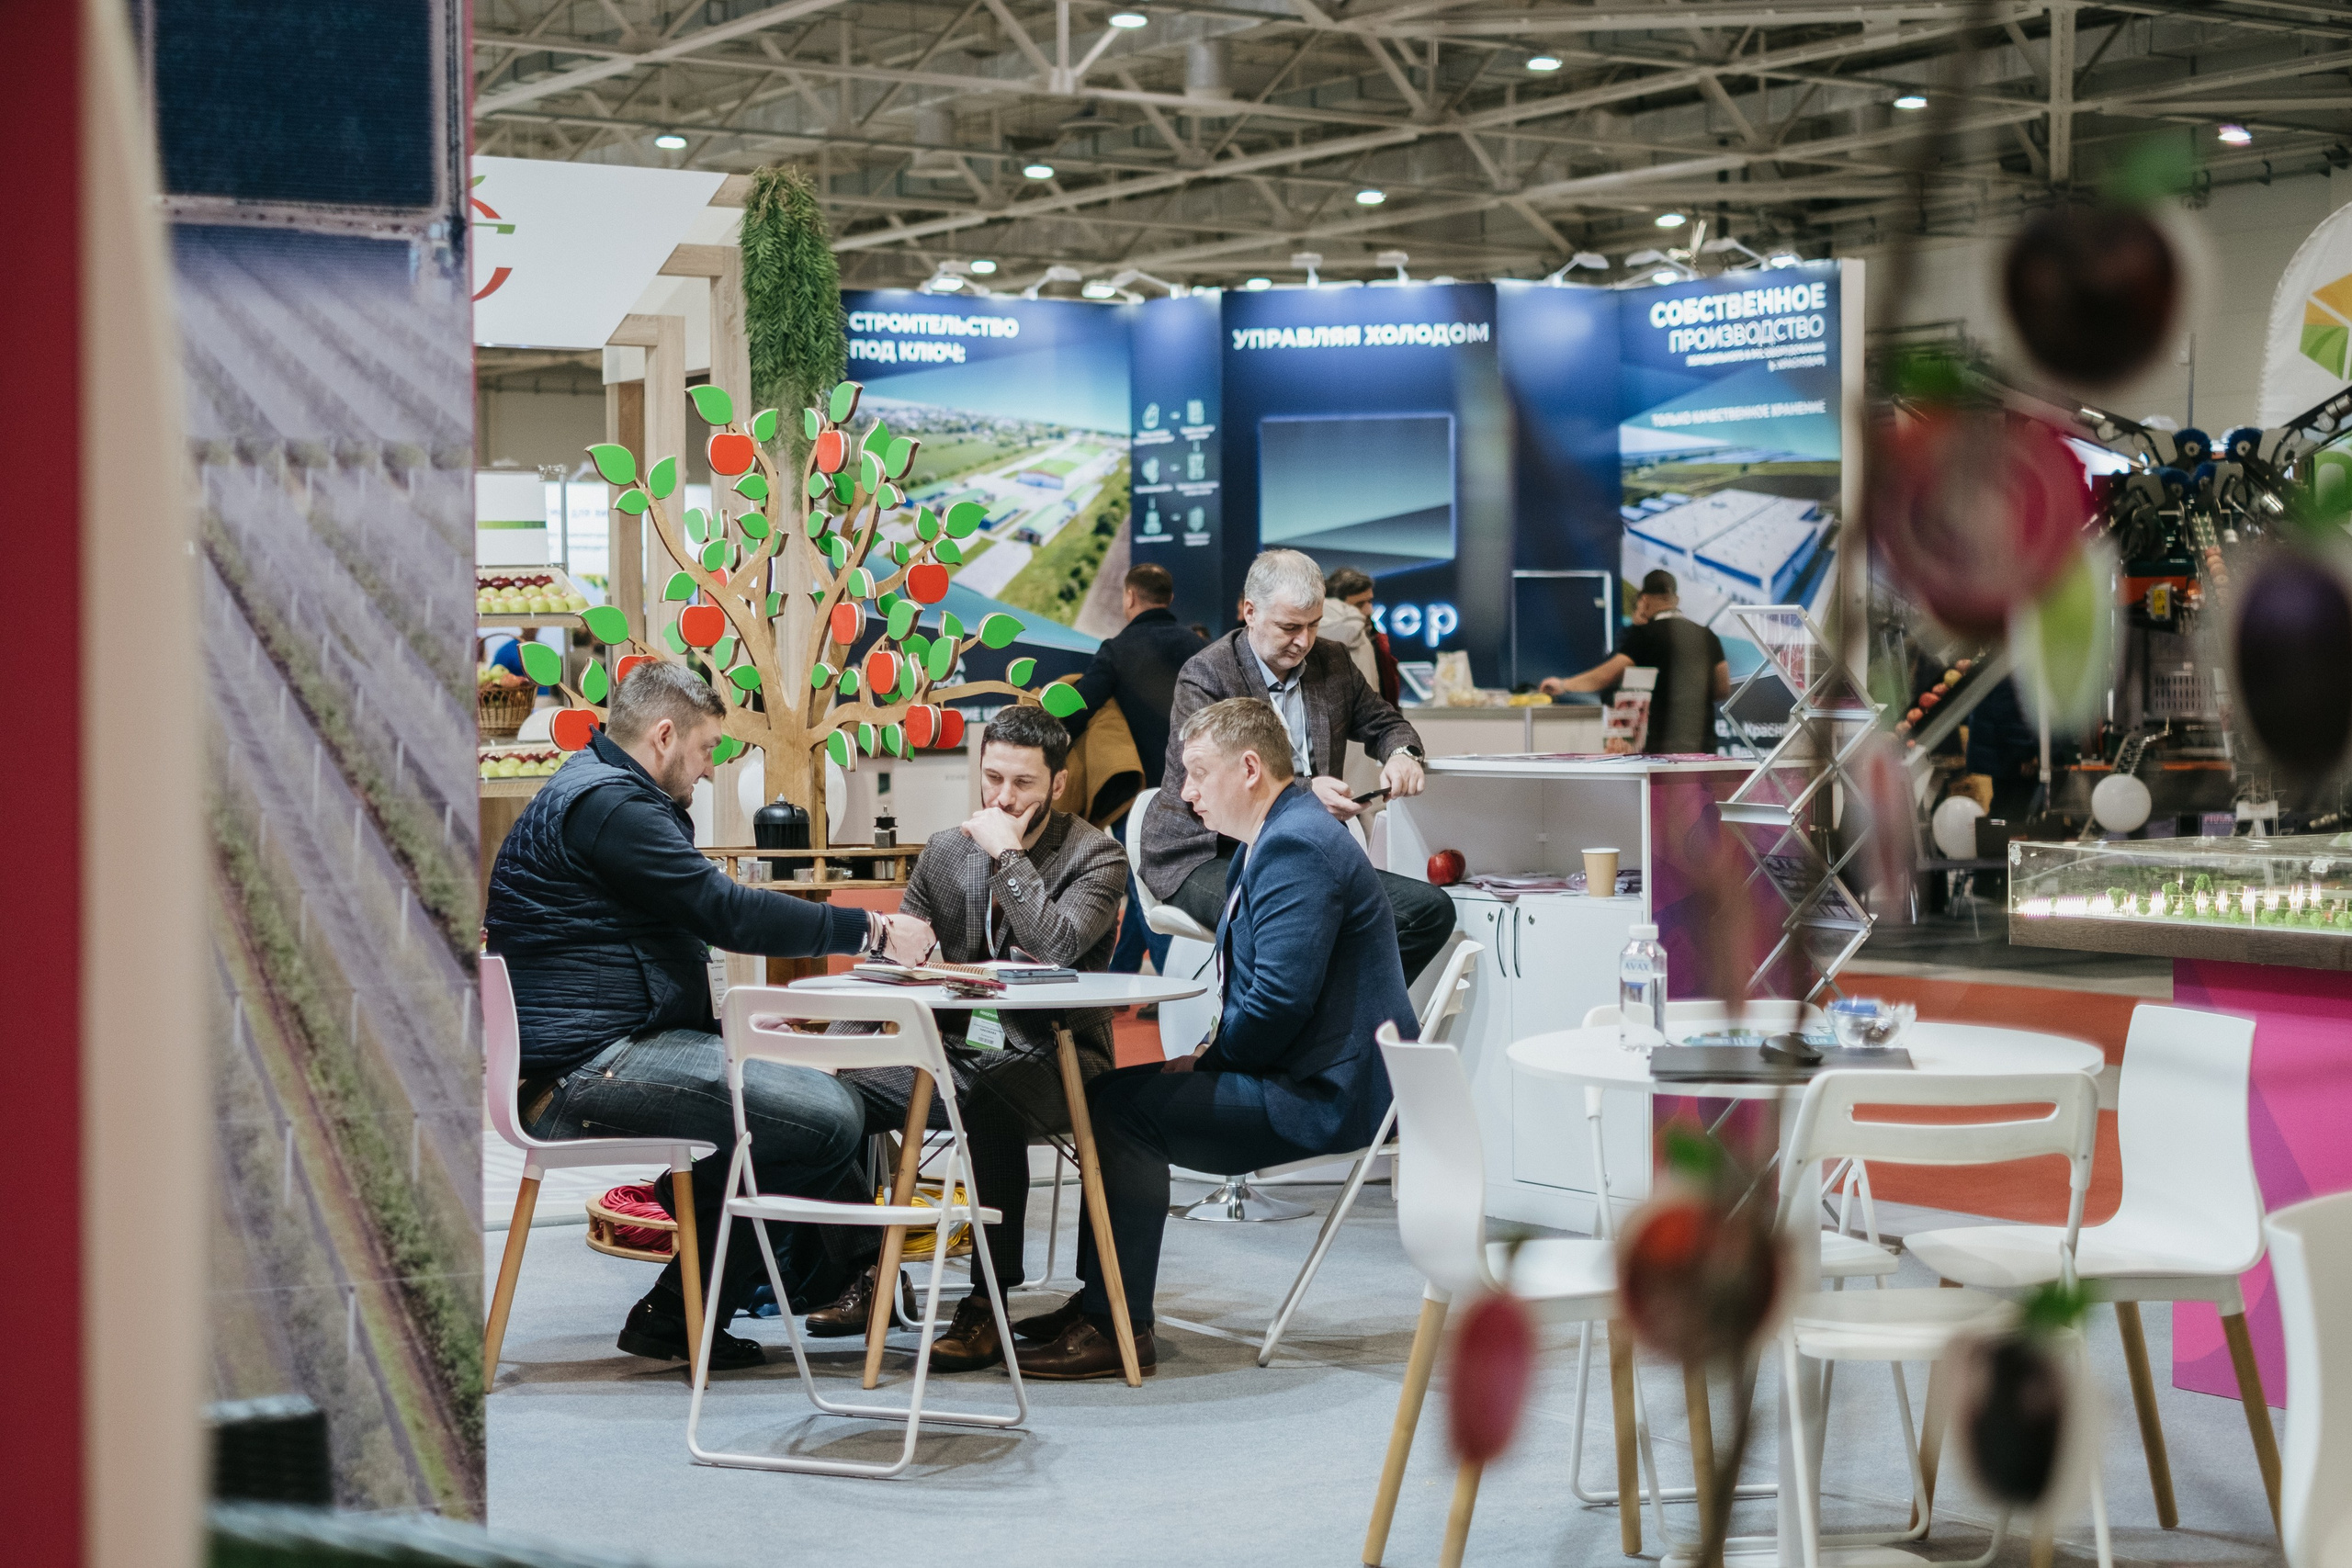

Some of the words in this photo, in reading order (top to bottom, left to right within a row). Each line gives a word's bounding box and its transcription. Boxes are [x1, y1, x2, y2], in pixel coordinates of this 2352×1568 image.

[1649, 281, 1827, 329] СОБСТВЕННОЕ
[848, 310, 1020, 339] СТРОИТЕЛЬСТВО
[1232, 325, 1362, 350] УПРАВЛЯЯ
[1363, 322, 1490, 347] ХОЛОДОМ
[1668, 313, 1826, 354] ПРОИЗВОДСТВО
[849, 338, 898, 364] ПОД
